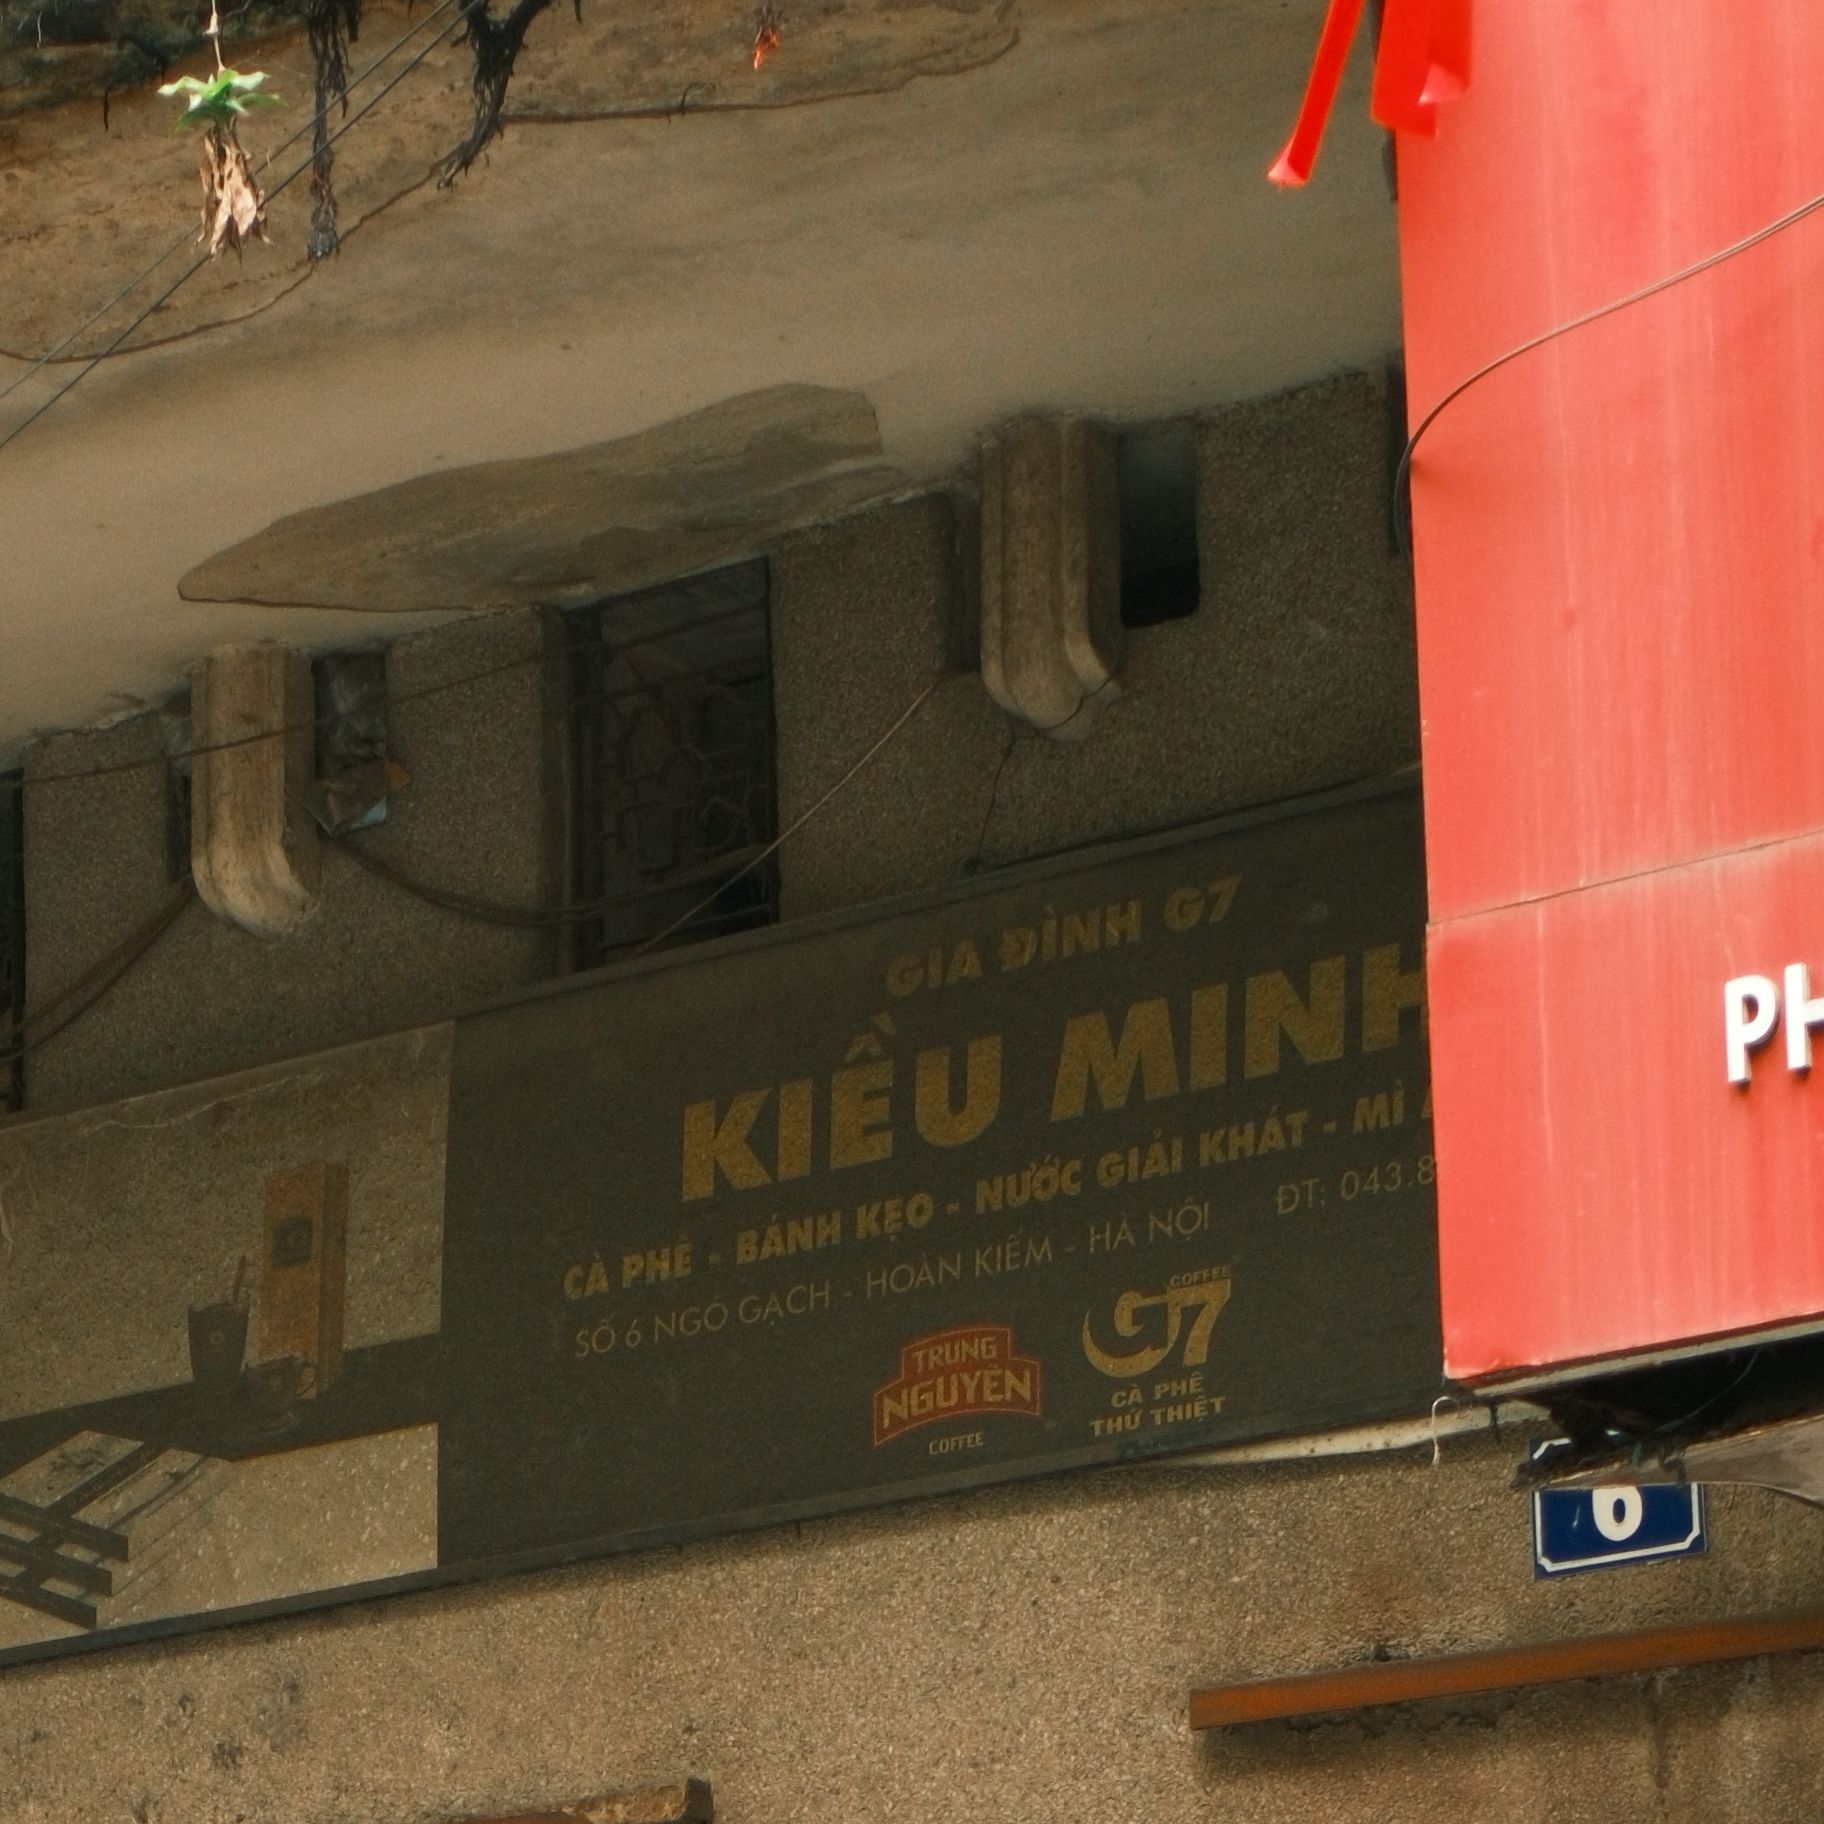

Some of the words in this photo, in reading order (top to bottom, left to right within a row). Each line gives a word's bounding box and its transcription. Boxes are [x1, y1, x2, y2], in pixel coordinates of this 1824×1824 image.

[885, 940, 982, 998] GIA
[1000, 898, 1142, 973] ĐÌNH
[1166, 873, 1242, 931] G7
[682, 1012, 1002, 1199] KIỀU
[563, 1257, 609, 1299] CÀ
[621, 1234, 692, 1288] PHÊ
[736, 1211, 842, 1265] BÁNH
[856, 1193, 934, 1242] KẸO
[976, 1153, 1082, 1214] NƯỚC
[1096, 1129, 1183, 1187] GIẢI
[1199, 1107, 1310, 1166] KHÁT
[576, 1314, 616, 1358] SỐ
[626, 1321, 642, 1348] 6
[739, 1281, 829, 1325] GẠCH
[866, 1252, 960, 1299] HOÀN
[975, 1228, 1053, 1277] KIẾM
[1090, 1218, 1135, 1253] HÀ
[1148, 1195, 1211, 1242] NỘI
[1170, 1265, 1232, 1288] COFFEE
[912, 1336, 998, 1375] TRUNG
[882, 1365, 1033, 1428] NGUYÊN
[1110, 1384, 1145, 1409] CÀ
[1153, 1372, 1205, 1399] PHÊ
[929, 1431, 984, 1455] COFFEE
